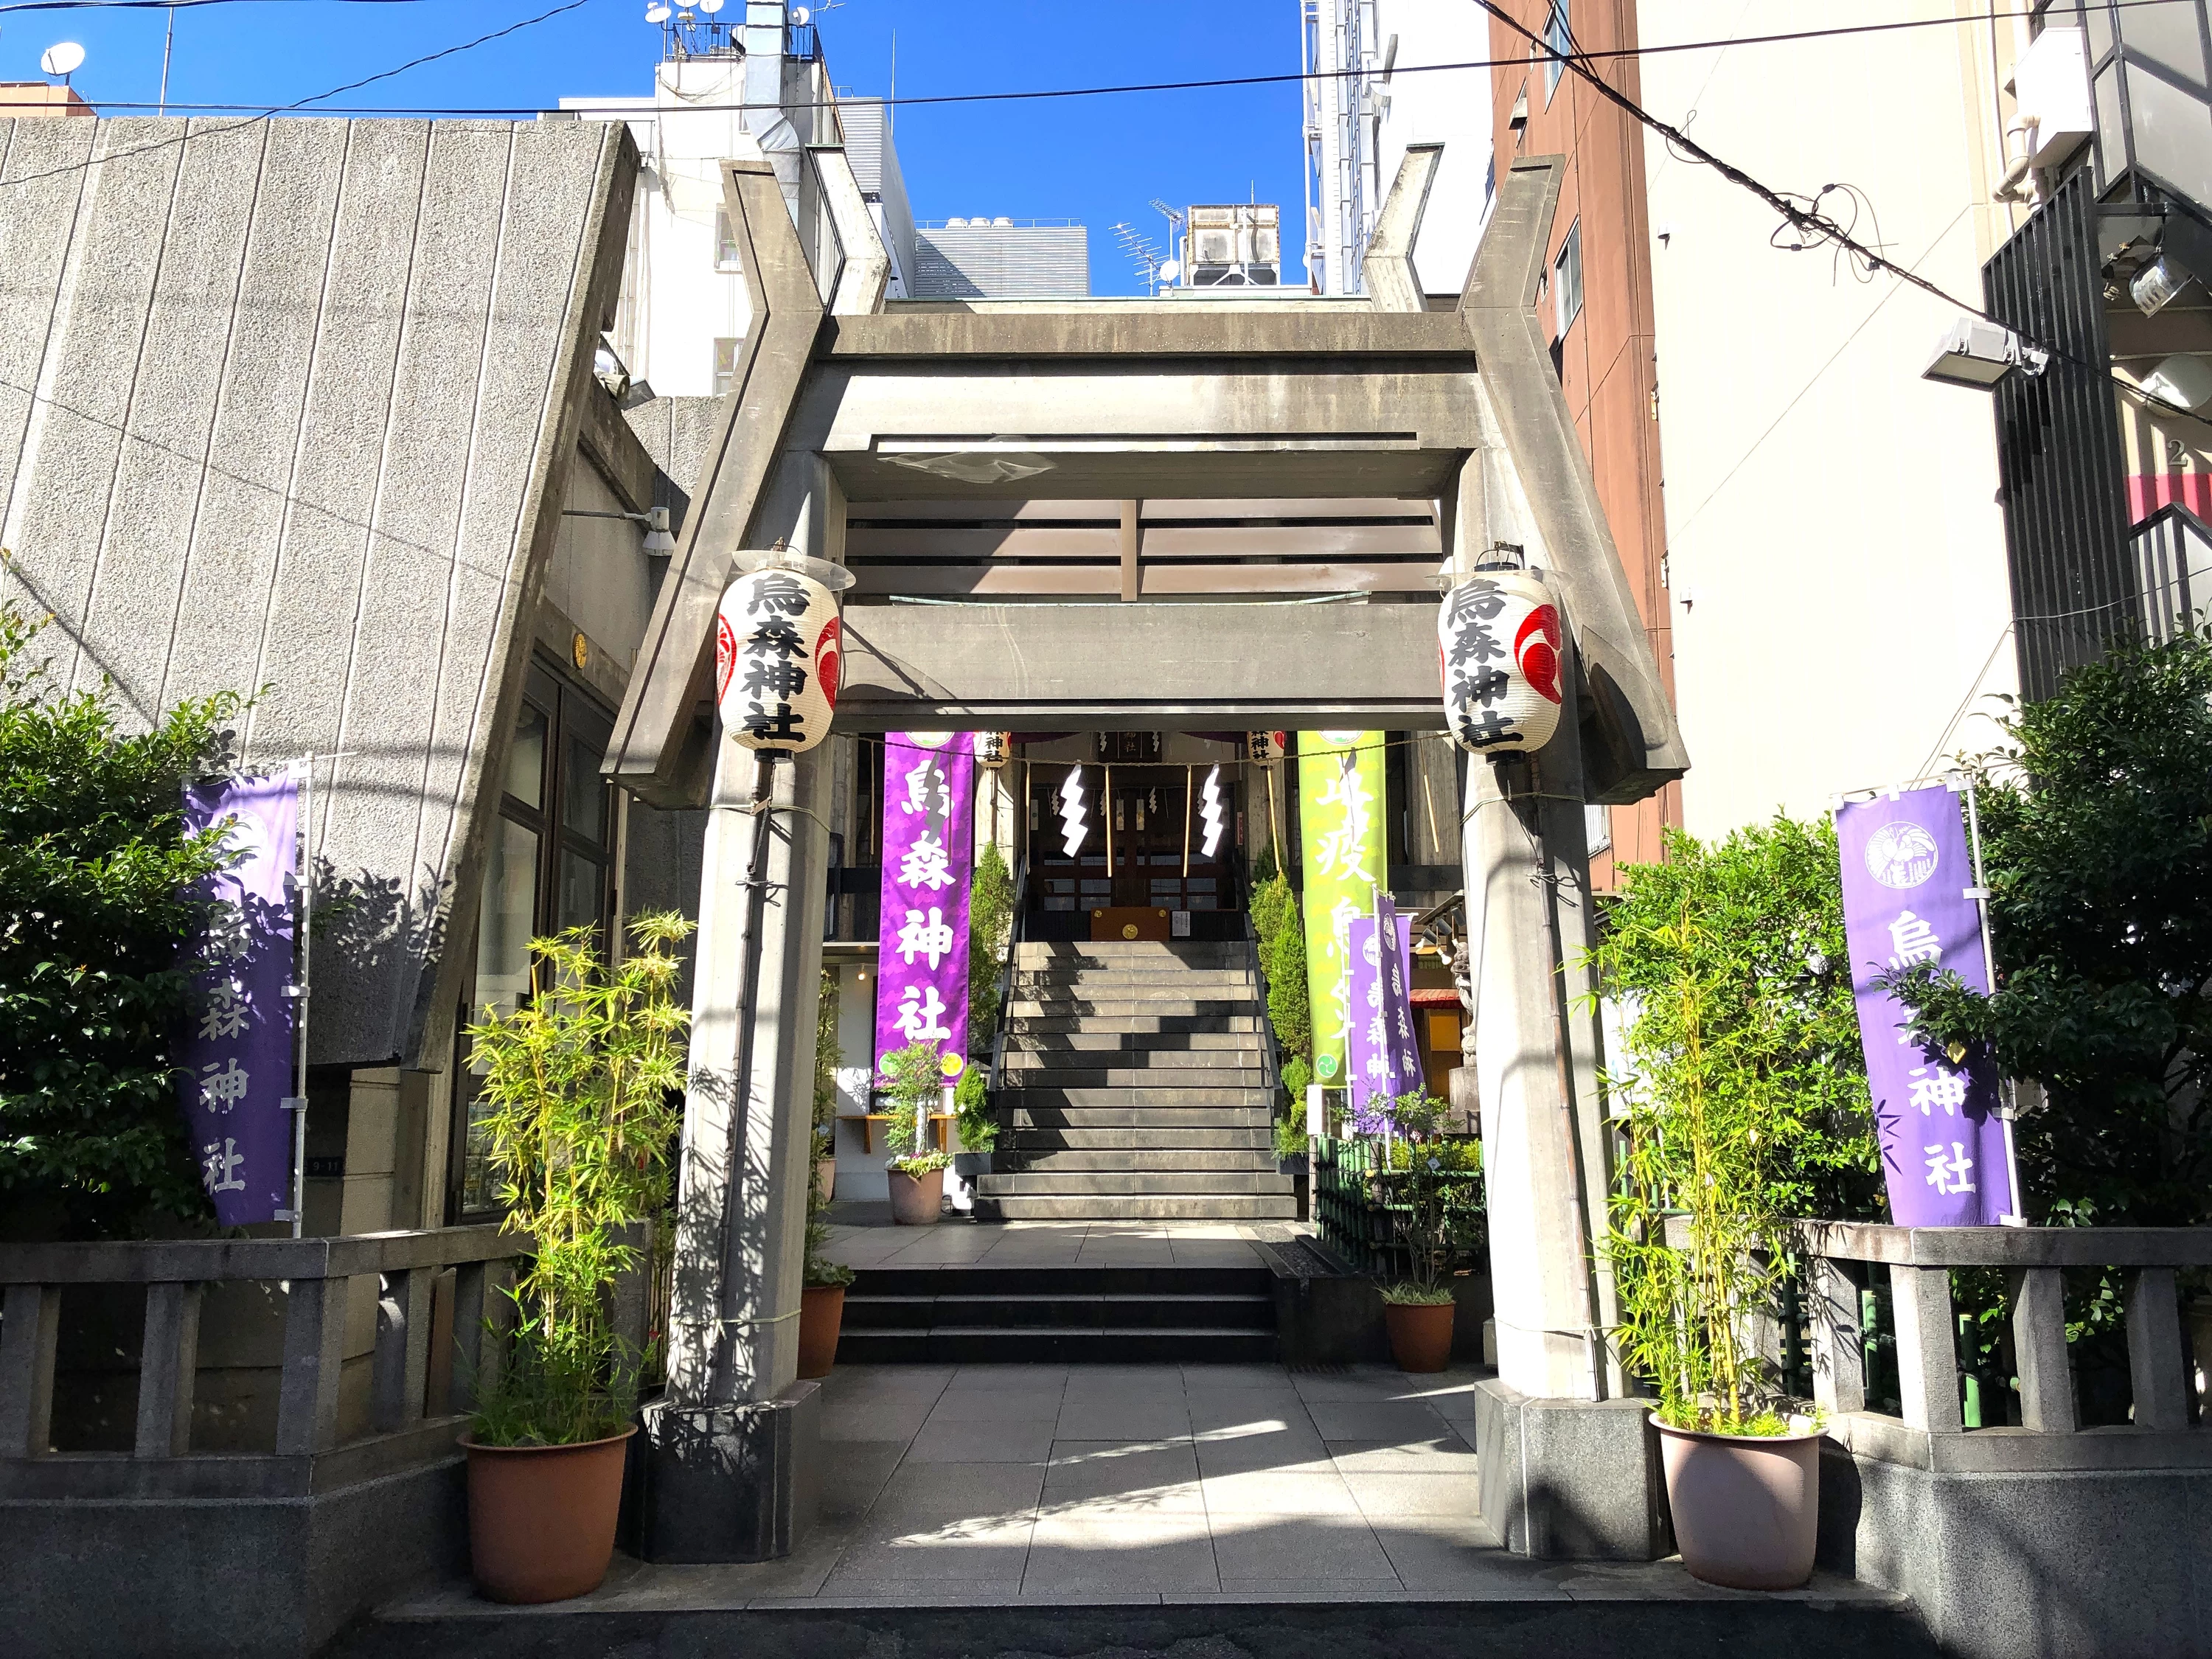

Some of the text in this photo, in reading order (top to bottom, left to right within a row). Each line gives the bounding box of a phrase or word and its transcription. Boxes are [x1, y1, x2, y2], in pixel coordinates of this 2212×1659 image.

[2168, 439, 2188, 466] 2
[740, 573, 812, 743] 烏森神社
[1447, 579, 1524, 748] 烏森神社
[984, 731, 1004, 763] 神社
